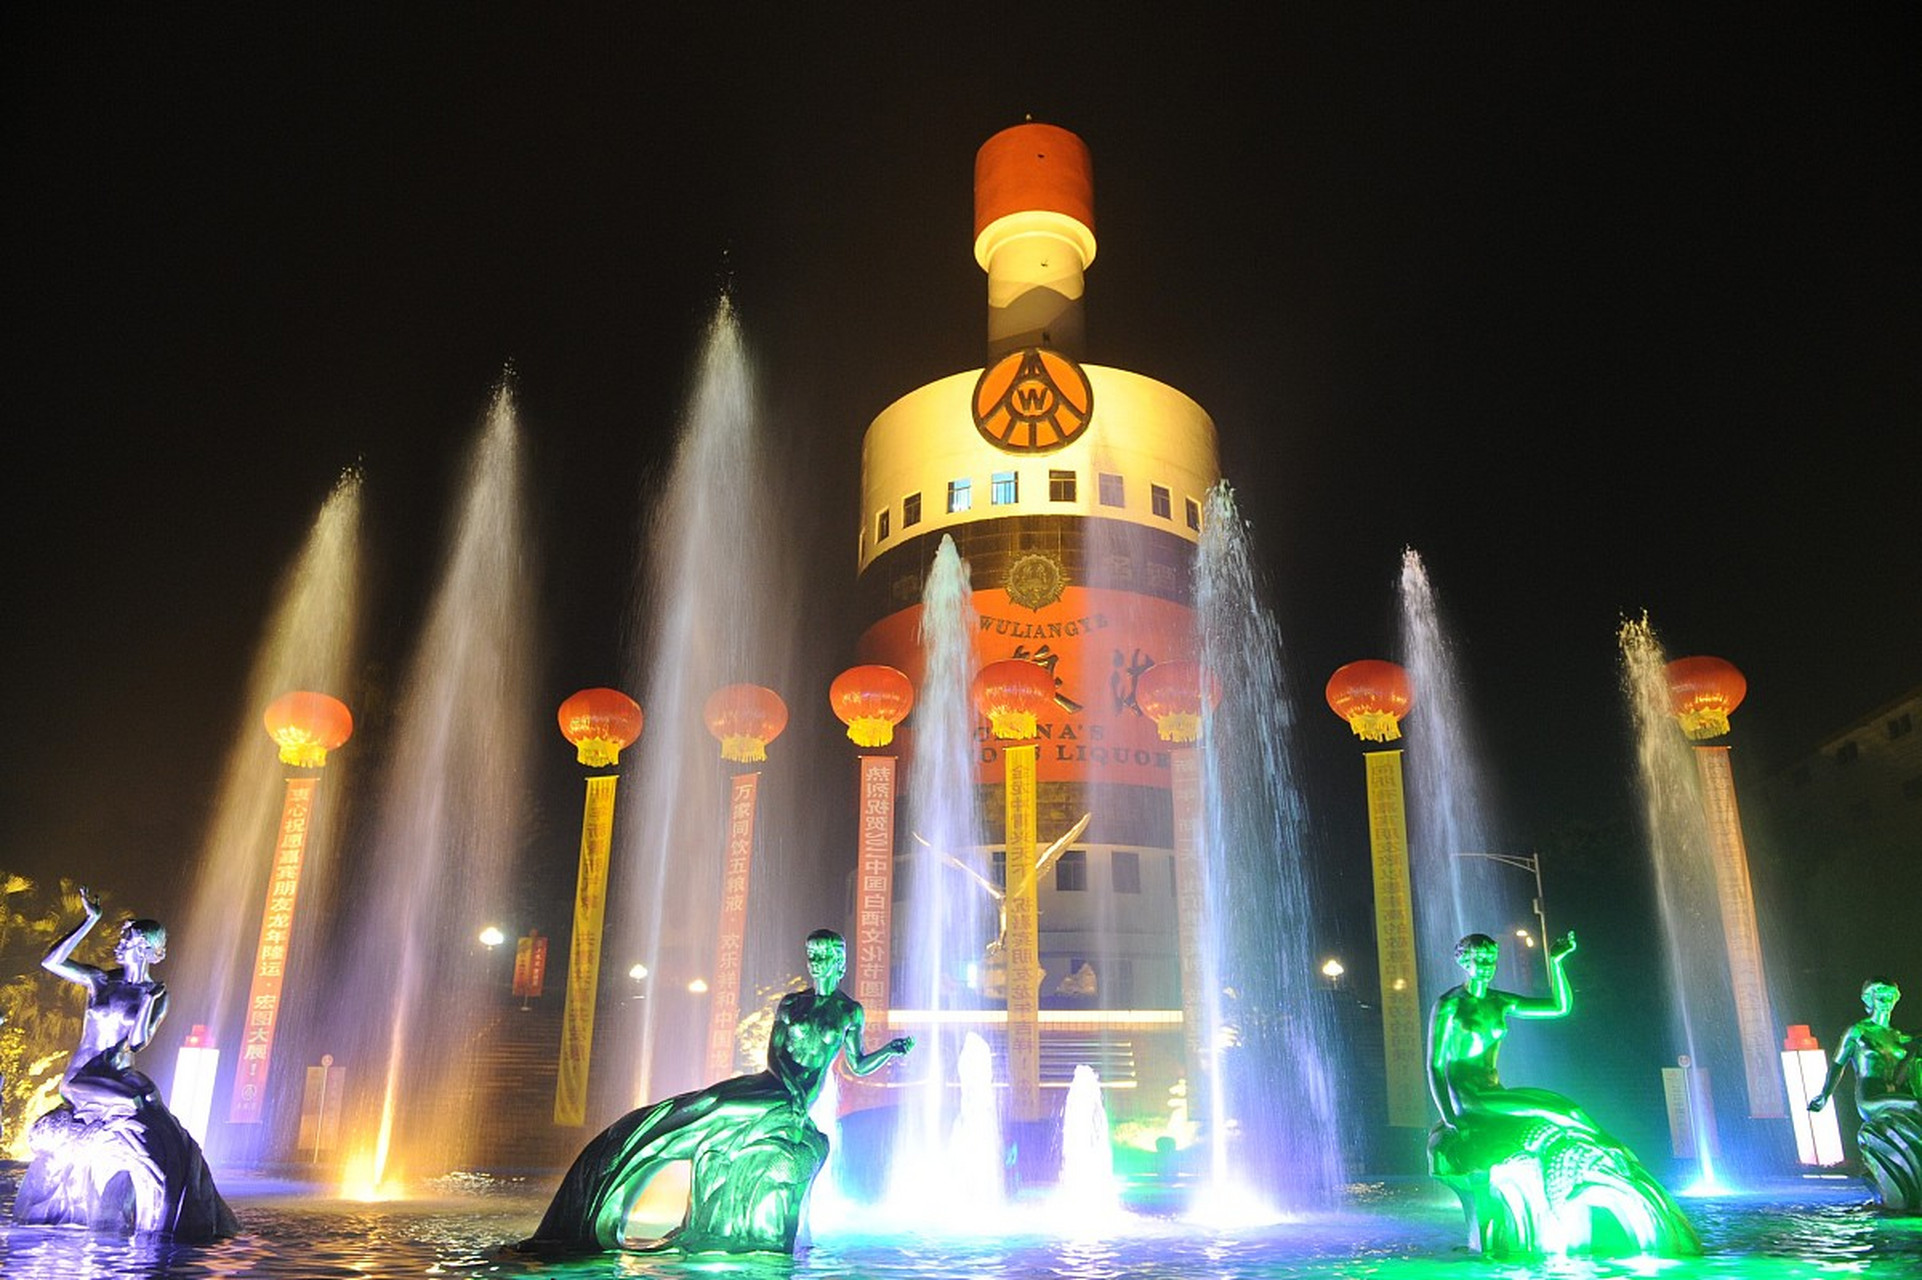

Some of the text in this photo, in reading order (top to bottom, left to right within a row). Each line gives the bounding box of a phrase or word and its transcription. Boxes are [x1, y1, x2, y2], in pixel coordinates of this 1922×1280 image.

[1017, 386, 1049, 411] W
[979, 613, 1109, 639] WULIANGYE
[974, 724, 1104, 742] CNA'S
